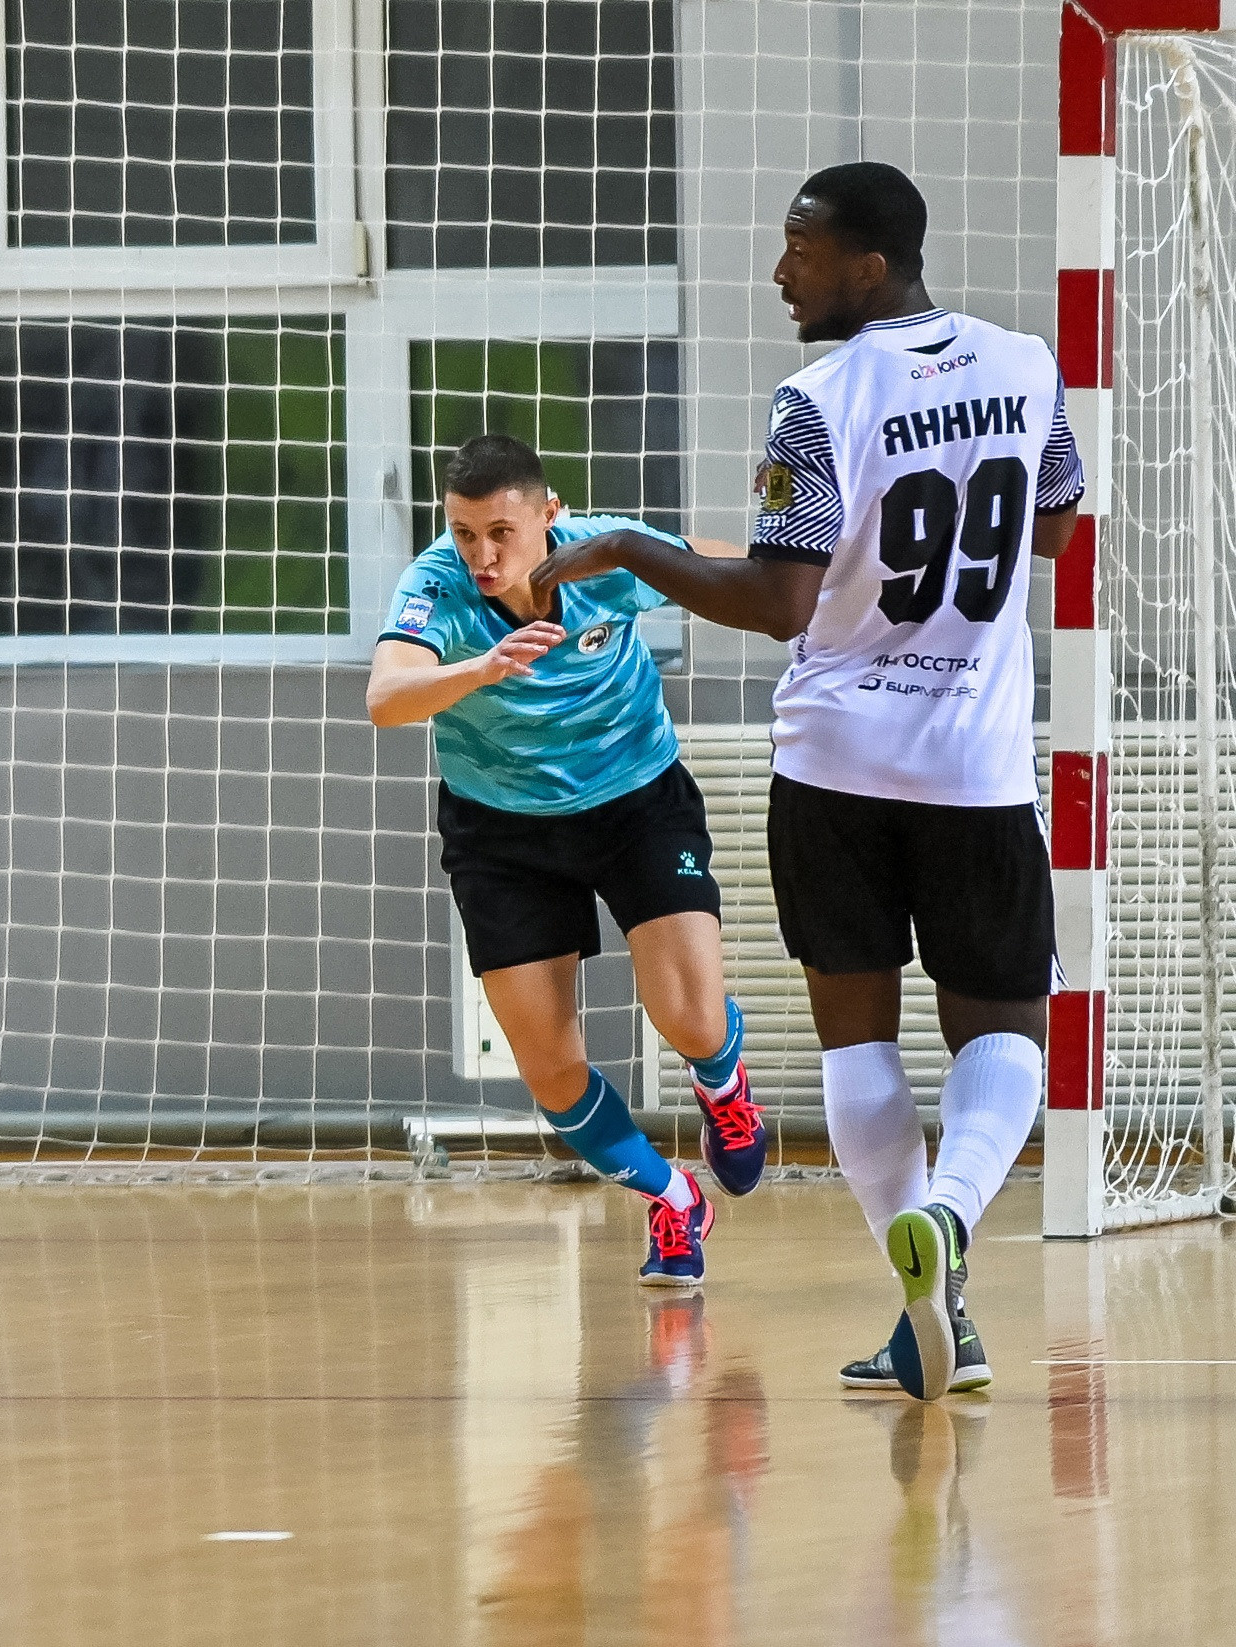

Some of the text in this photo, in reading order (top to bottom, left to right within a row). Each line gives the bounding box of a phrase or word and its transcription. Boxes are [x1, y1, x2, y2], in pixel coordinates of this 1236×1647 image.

[937, 352, 977, 373] ЮКОН
[881, 396, 1027, 457] ЯННИК
[877, 456, 1028, 626] 99
